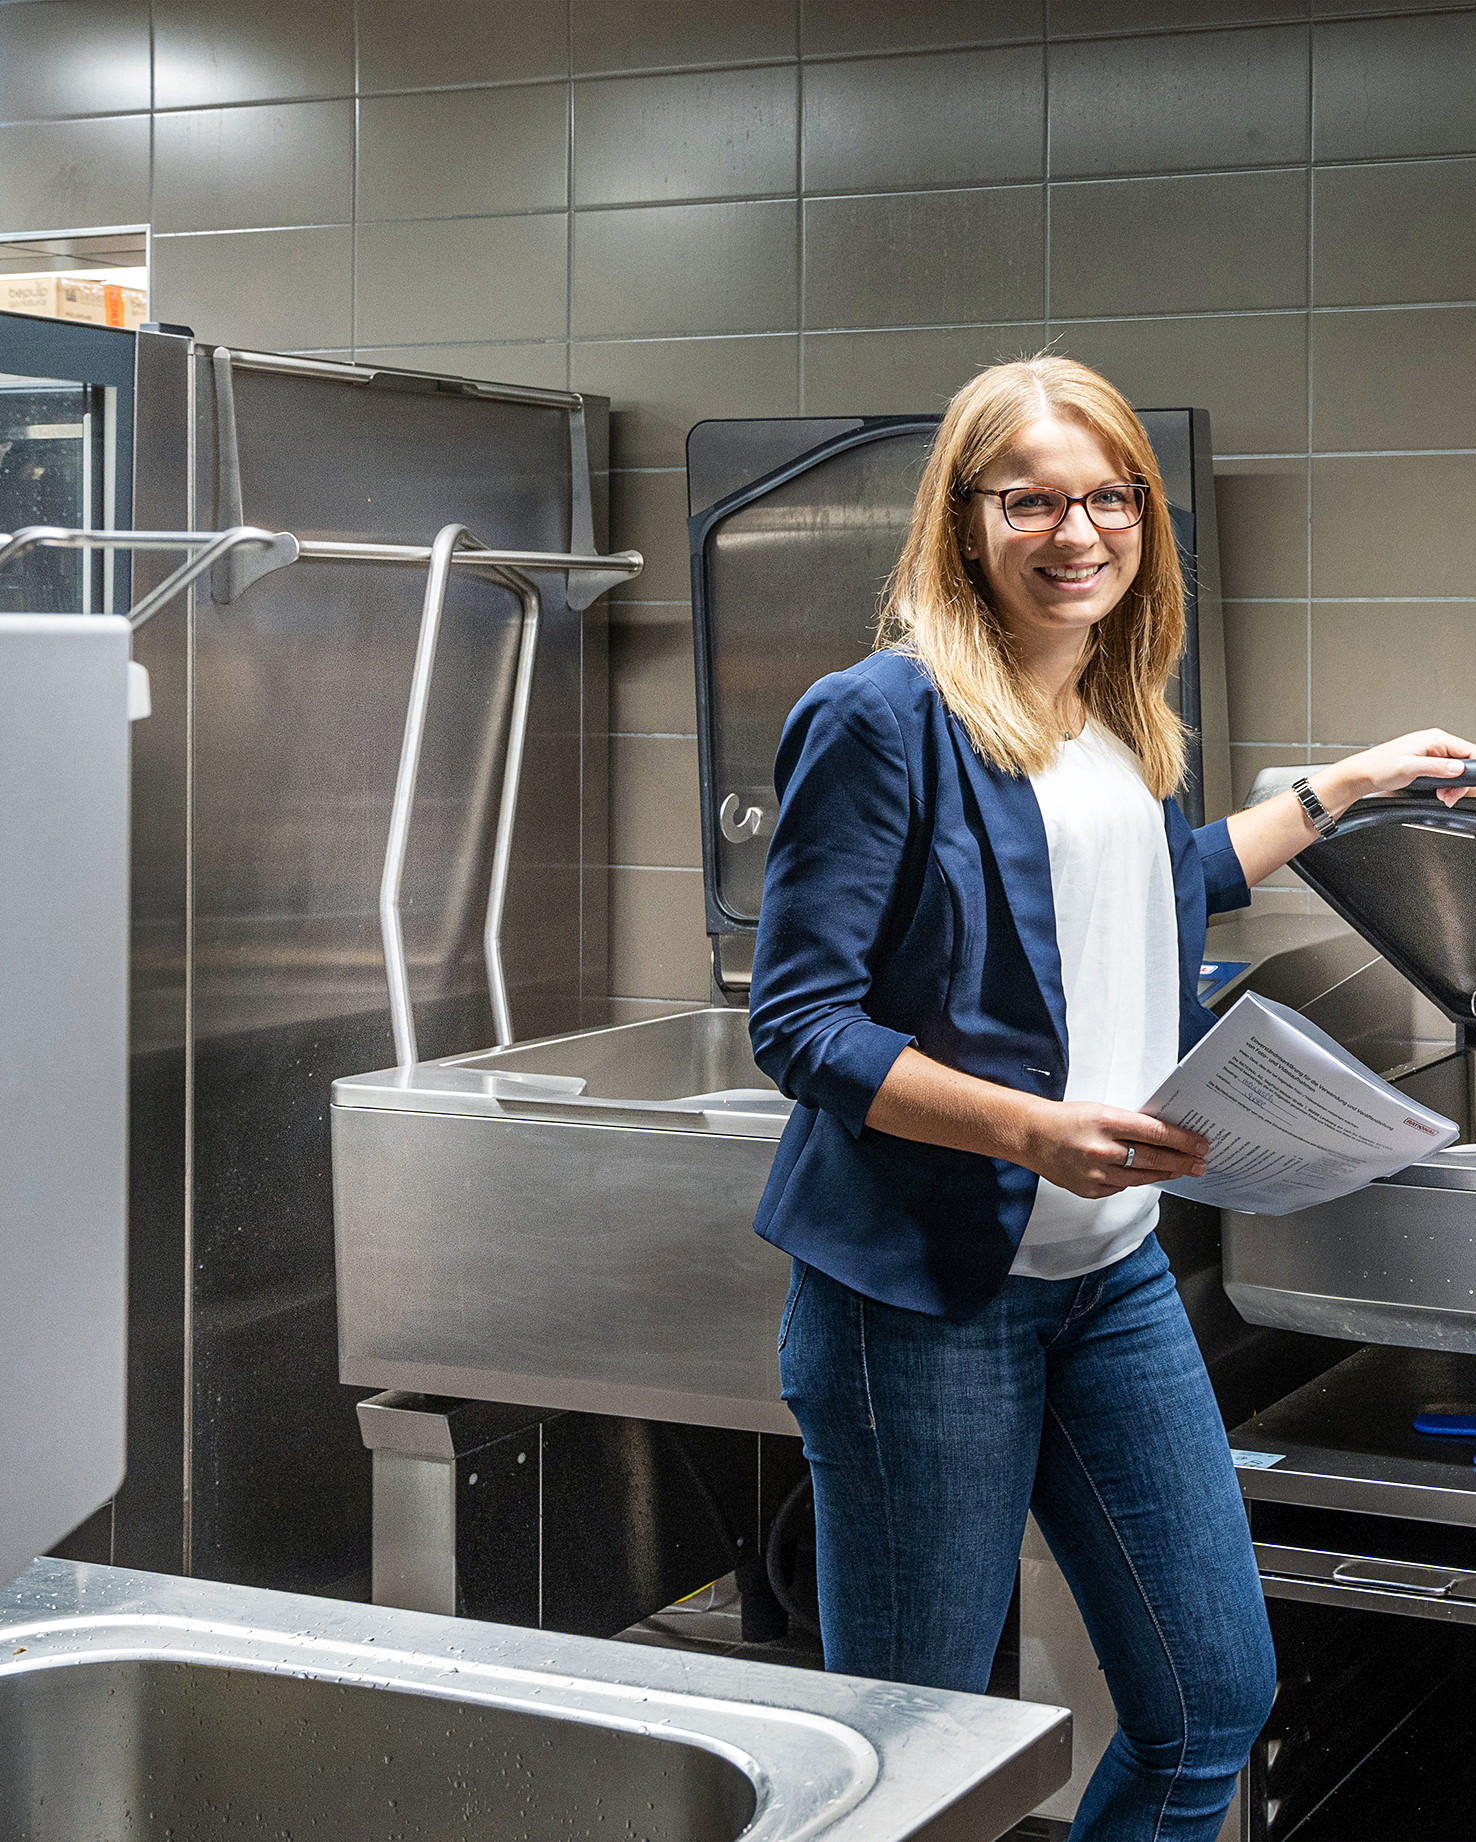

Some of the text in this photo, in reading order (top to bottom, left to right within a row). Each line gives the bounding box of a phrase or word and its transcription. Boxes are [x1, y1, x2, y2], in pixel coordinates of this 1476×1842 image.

[1244, 1041, 1255, 1050] von
[1267, 1057, 1278, 1067] und
[1309, 1078, 1319, 1087] die
[1318, 1084, 1347, 1106] Verwendung
[1346, 1102, 1358, 1111] und
